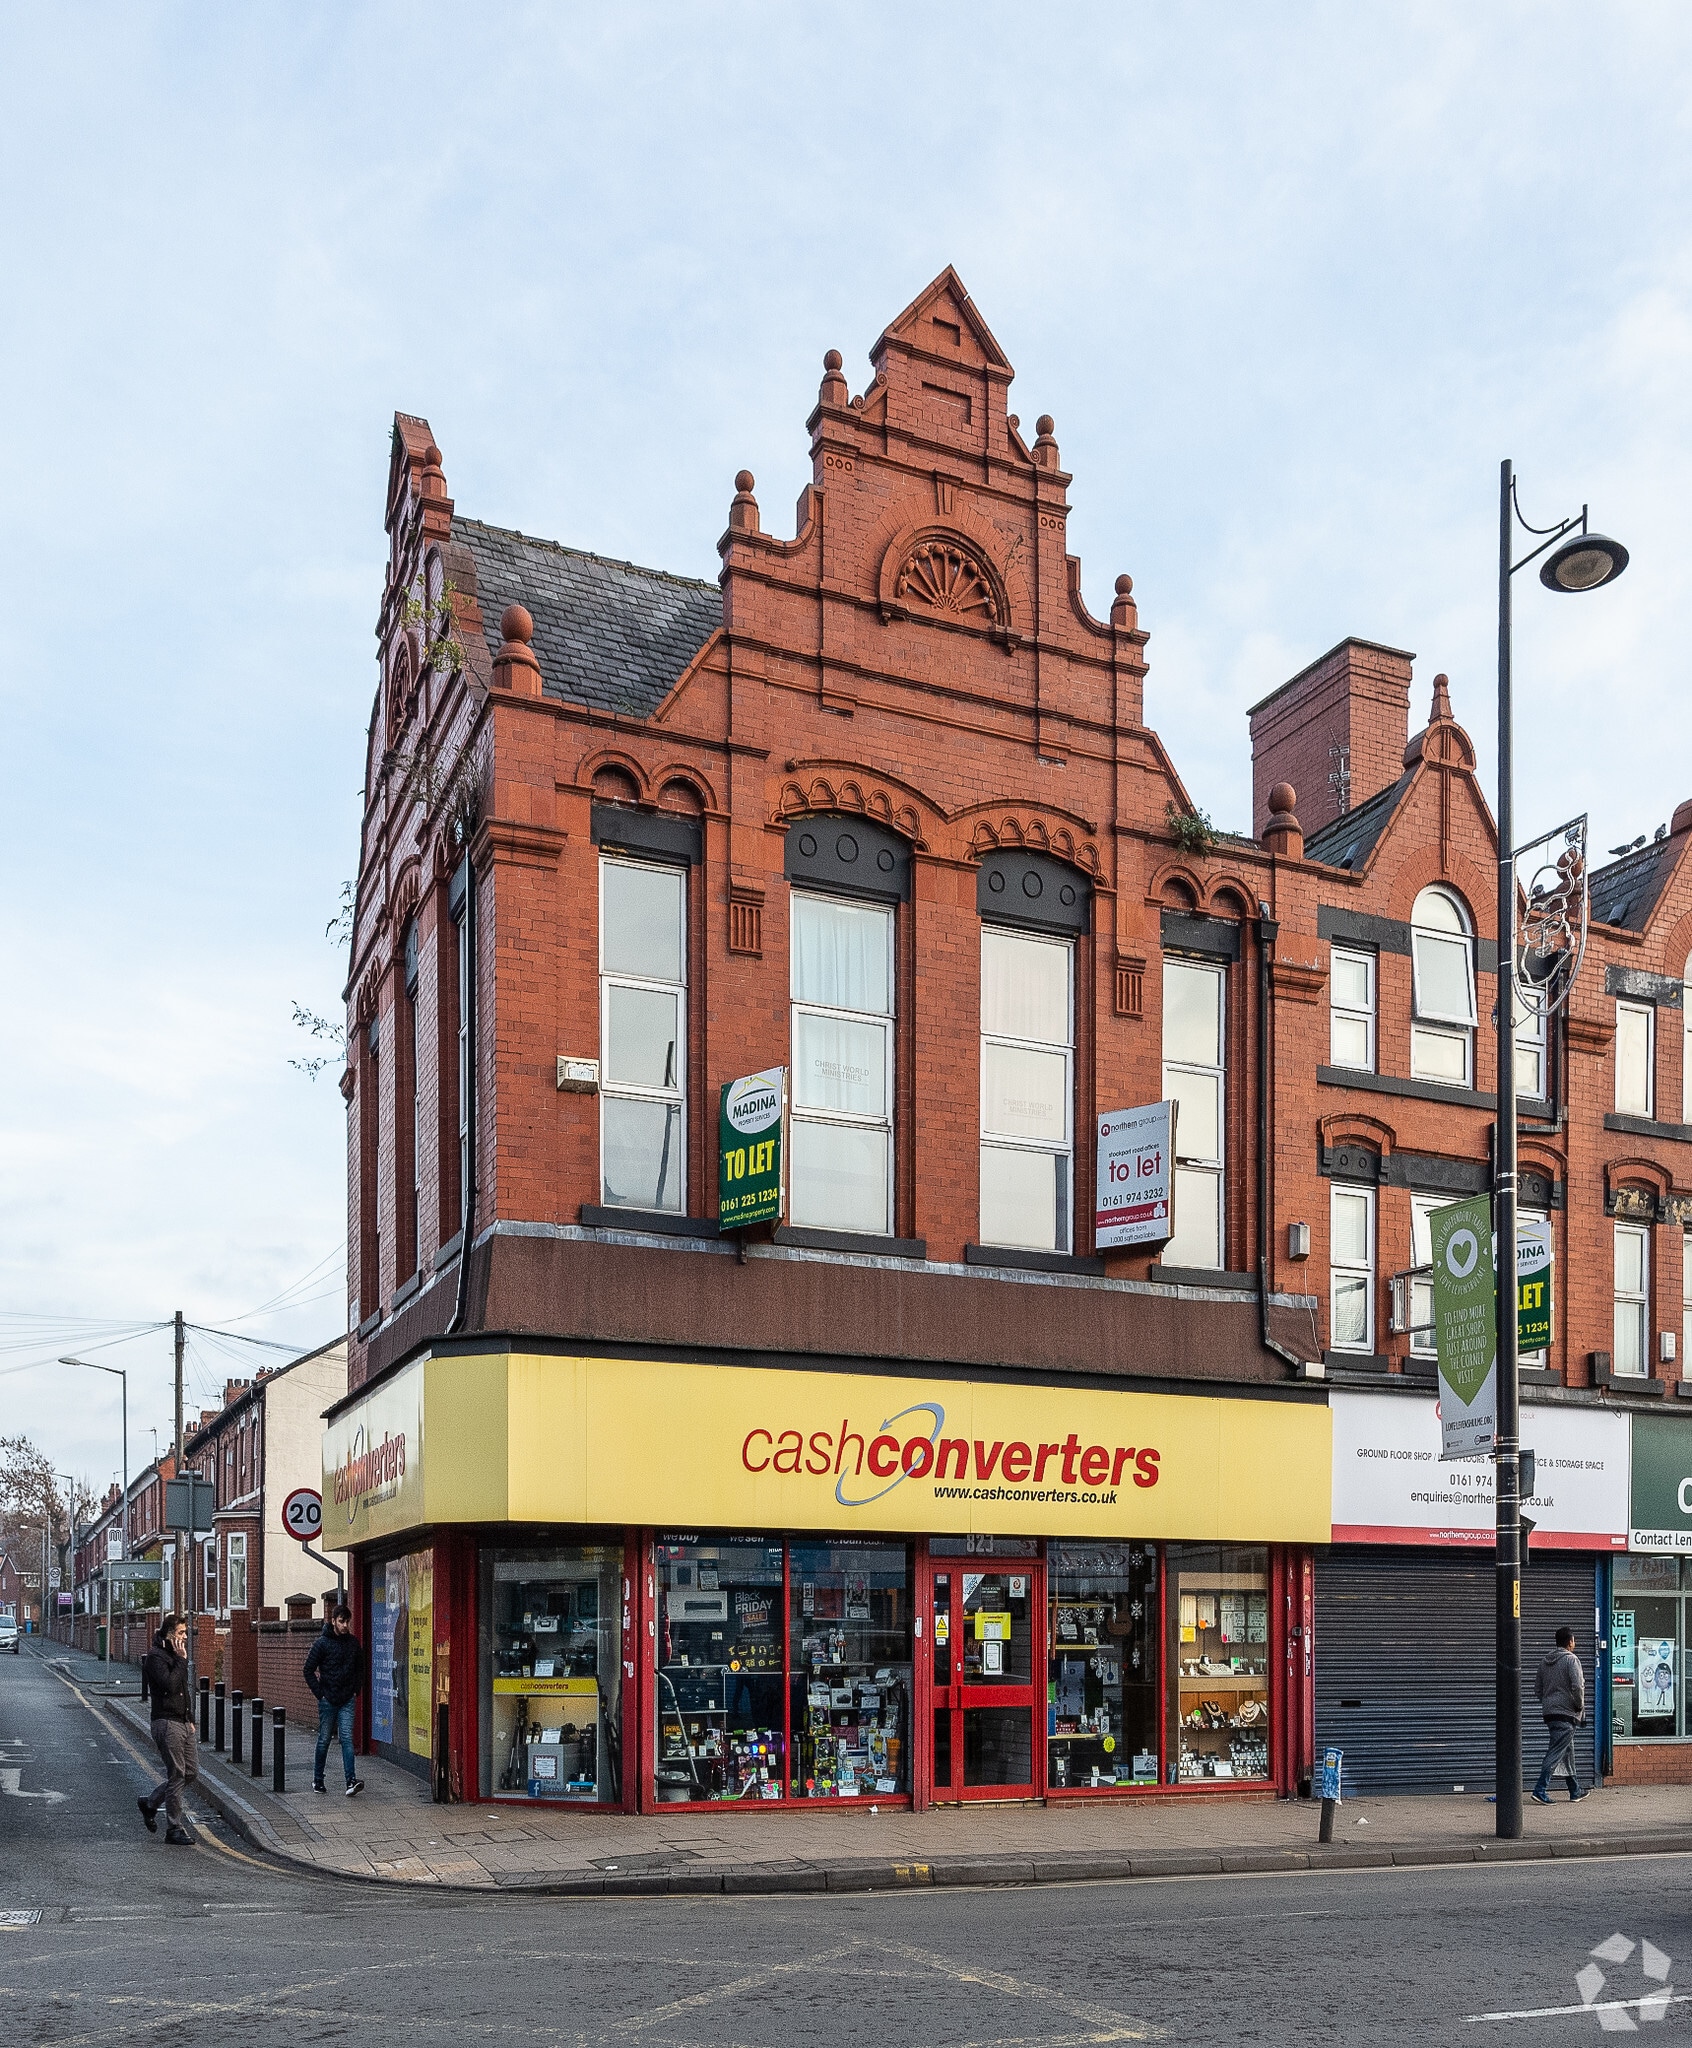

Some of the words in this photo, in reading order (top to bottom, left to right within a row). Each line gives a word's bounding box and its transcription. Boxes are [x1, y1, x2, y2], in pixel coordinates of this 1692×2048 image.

[815, 1060, 841, 1071] CHRIST
[842, 1064, 869, 1077] WORLD
[821, 1068, 862, 1082] MINISTRIES
[732, 1094, 777, 1119] MADINA
[1028, 1101, 1053, 1111] WORLD
[1111, 1120, 1138, 1132] northern
[1108, 1148, 1132, 1158] stockport
[1144, 1143, 1160, 1151] offices
[725, 1147, 745, 1182] TO
[748, 1139, 775, 1176] LET
[1109, 1160, 1129, 1182] to
[1136, 1151, 1161, 1178] let
[721, 1198, 739, 1213] 0161
[741, 1193, 756, 1208] 225
[758, 1187, 778, 1204] 1234
[1102, 1194, 1122, 1207] 0161
[1127, 1191, 1142, 1203] 974
[1143, 1187, 1164, 1200] 3232
[1110, 1235, 1124, 1244] 1,000
[1435, 1233, 1446, 1252] LOVE
[1440, 1274, 1452, 1292] LOVE
[1444, 1311, 1453, 1326] TO
[1453, 1308, 1468, 1324] FIND
[1469, 1303, 1486, 1320] MORE
[1446, 1323, 1466, 1341] GREAT
[1466, 1320, 1486, 1337] SHOPS
[1526, 1321, 1549, 1333] 1234
[1446, 1342, 1460, 1358] JUST
[1461, 1336, 1487, 1353] AROUND
[1450, 1357, 1460, 1371] THE
[1460, 1352, 1485, 1369] CORNER
[1445, 1415, 1493, 1432] LOVELEVENSHULME.ORG
[742, 1418, 1161, 1488] cashconverters
[1356, 1449, 1389, 1460] GROUND
[1389, 1450, 1413, 1461] FLOOR
[1413, 1452, 1432, 1462] SHOP
[1548, 1459, 1554, 1468] &
[1555, 1460, 1584, 1470] STORAGE
[1585, 1460, 1605, 1471] SPACE
[1450, 1473, 1472, 1487] 0161
[1475, 1475, 1493, 1488] 974
[933, 1485, 1118, 1505] www.cashconverters.co.uk
[290, 1503, 321, 1524] 20
[966, 1534, 994, 1553] 823
[1634, 1531, 1672, 1546] Contact
[735, 1591, 761, 1604] Black
[735, 1598, 773, 1614] FRIDAY
[520, 1681, 569, 1690] cashconverters
